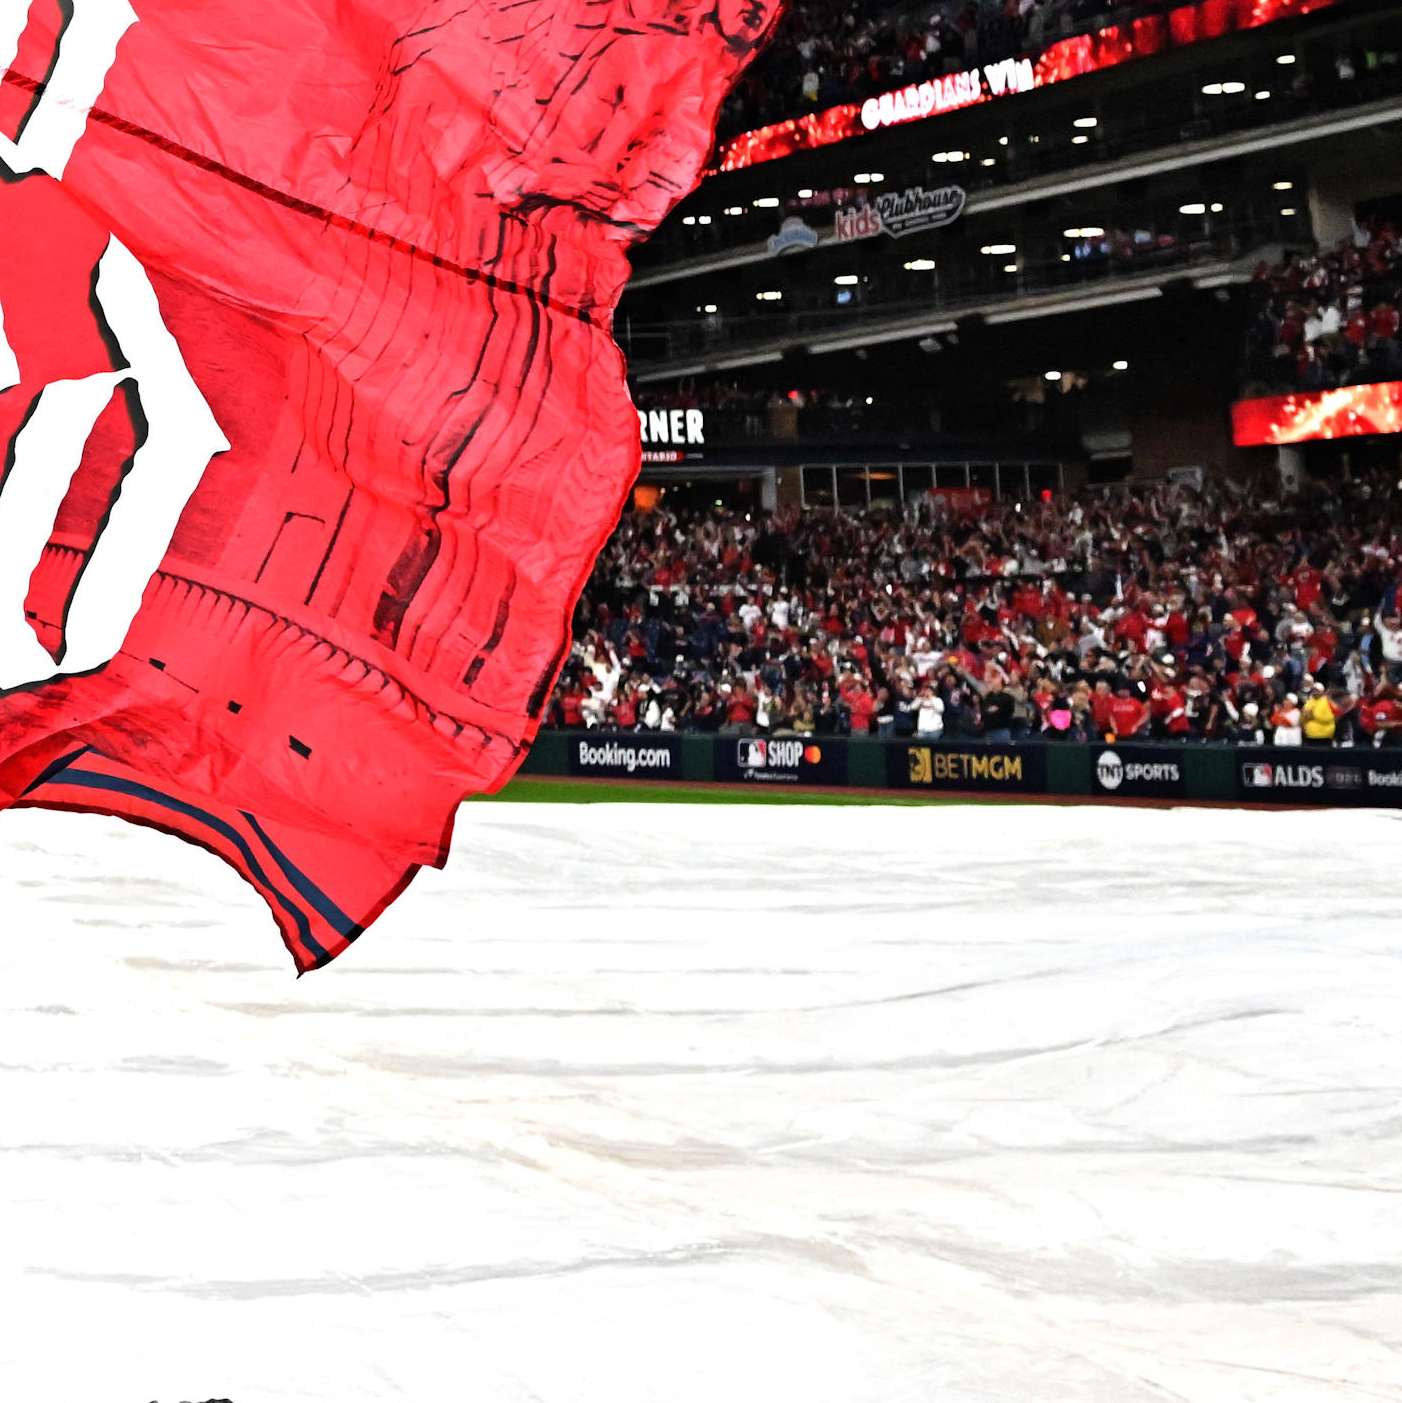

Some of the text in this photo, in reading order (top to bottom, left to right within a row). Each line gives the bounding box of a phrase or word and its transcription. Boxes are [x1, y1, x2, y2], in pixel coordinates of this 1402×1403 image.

[861, 58, 1034, 130] GUARDIANS WIN
[579, 741, 671, 772] Booking.com
[767, 740, 804, 768] SHOP
[934, 753, 1023, 780] BETMGM
[1125, 763, 1180, 781] SPORTS
[1275, 765, 1325, 788] ALDS
